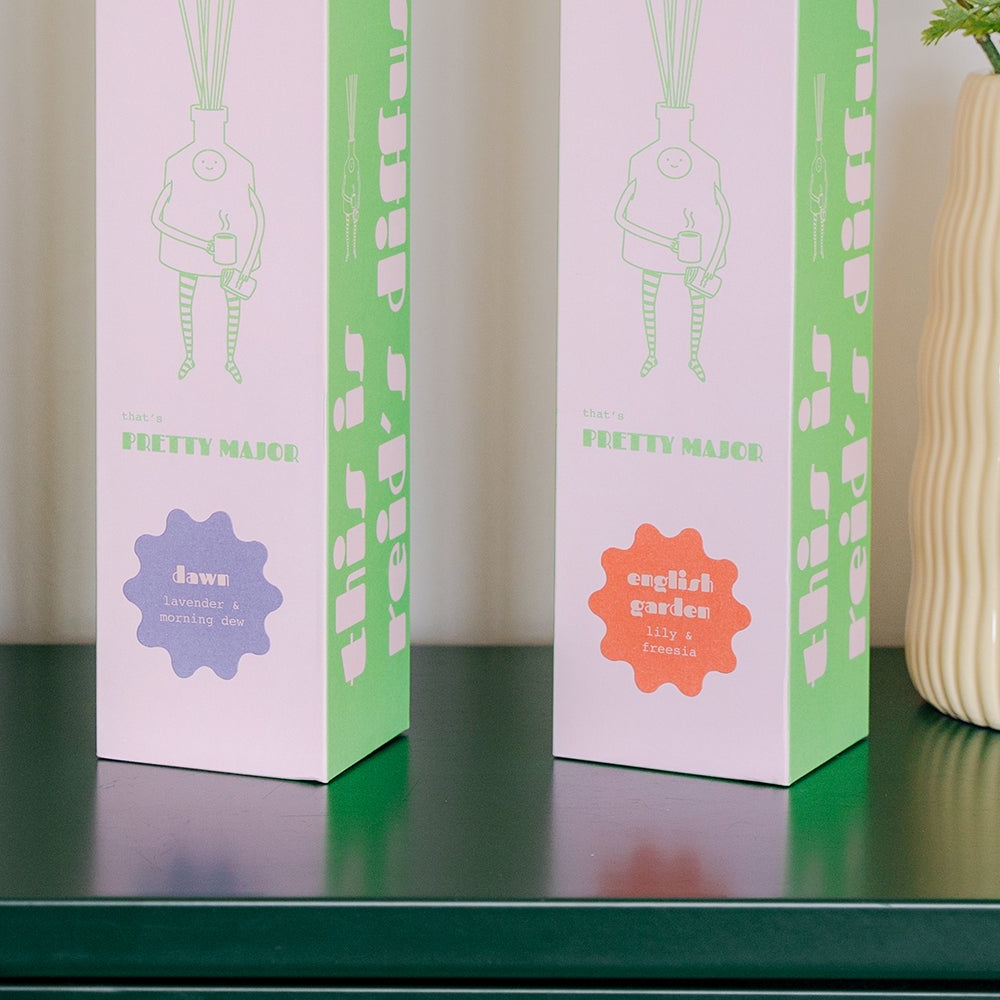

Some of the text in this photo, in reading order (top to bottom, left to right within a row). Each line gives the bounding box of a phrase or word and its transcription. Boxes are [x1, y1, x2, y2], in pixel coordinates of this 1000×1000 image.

[122, 411, 162, 423] that's
[583, 408, 624, 420] that's
[122, 431, 299, 463] PRETTY MAJOR
[582, 428, 763, 462] PRETTY MAJOR
[333, 325, 366, 686] this is
[376, 346, 407, 656] reid's
[797, 325, 832, 687] this is
[838, 348, 869, 660] reid's
[172, 565, 230, 587] dawn
[627, 569, 714, 593] english
[164, 595, 240, 610] lavender &
[630, 597, 711, 620] garden
[160, 613, 245, 627] morning dew
[647, 626, 693, 640] lily &
[642, 642, 697, 657] freesia
